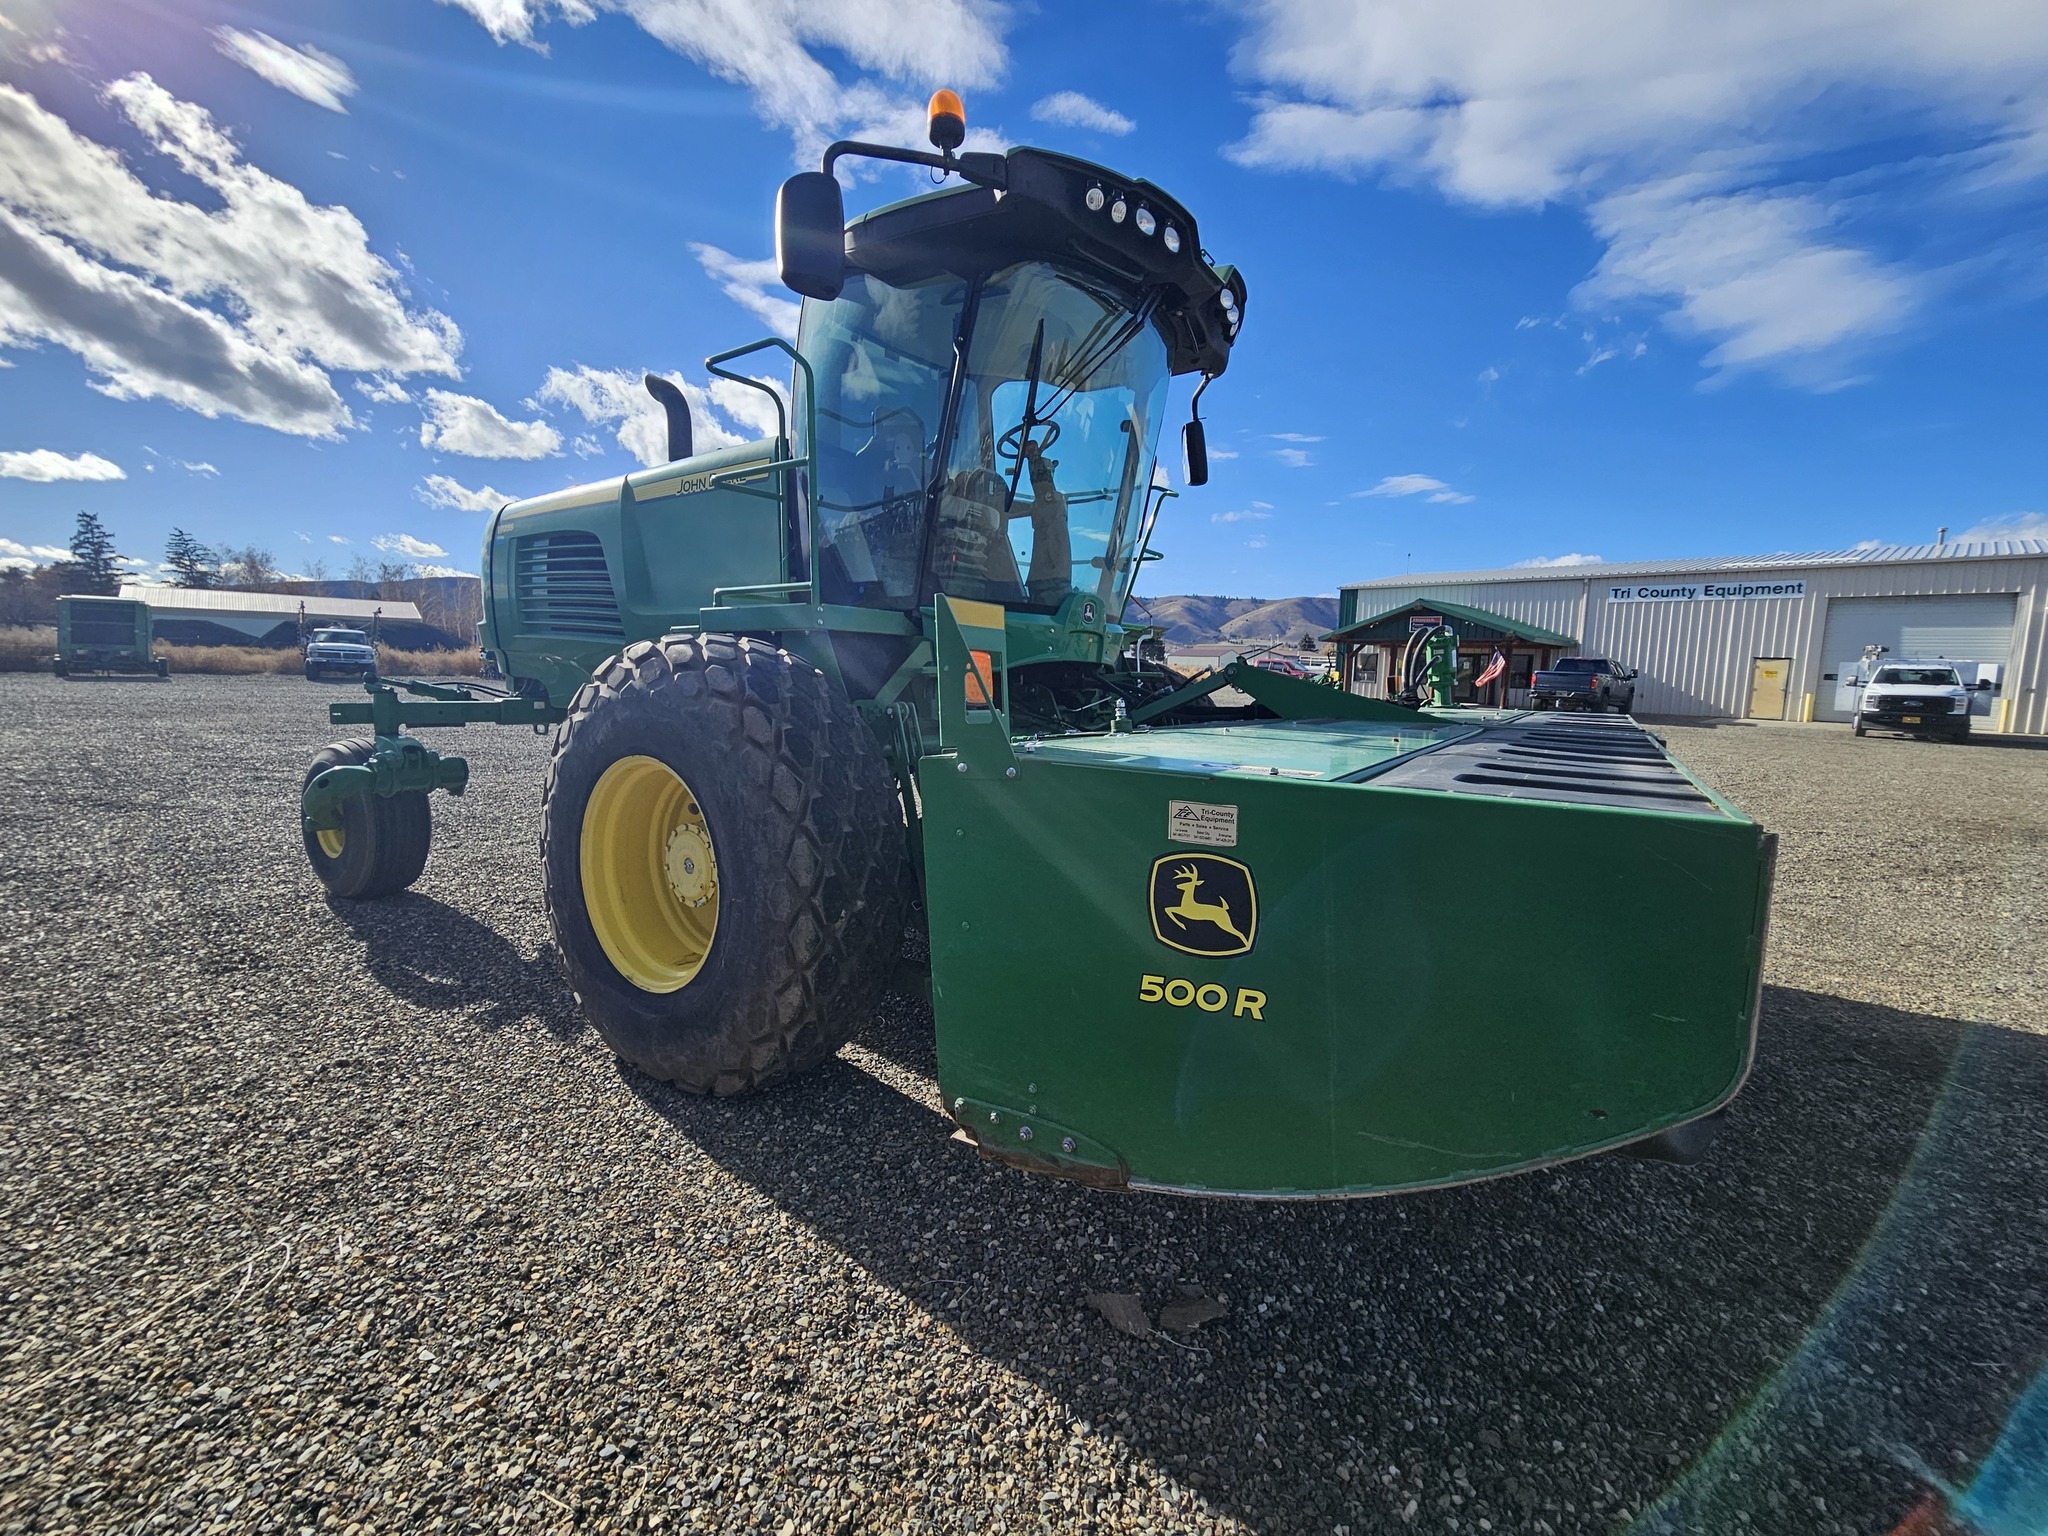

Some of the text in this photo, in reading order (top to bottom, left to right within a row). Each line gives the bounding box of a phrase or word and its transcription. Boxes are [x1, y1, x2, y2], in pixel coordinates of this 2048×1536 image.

[677, 478, 707, 494] JOHN
[1612, 582, 1804, 599] Tri County Equipment
[1200, 815, 1236, 825] Equipment
[1201, 808, 1235, 818] Tri-County
[1138, 973, 1268, 1022] 500 R
